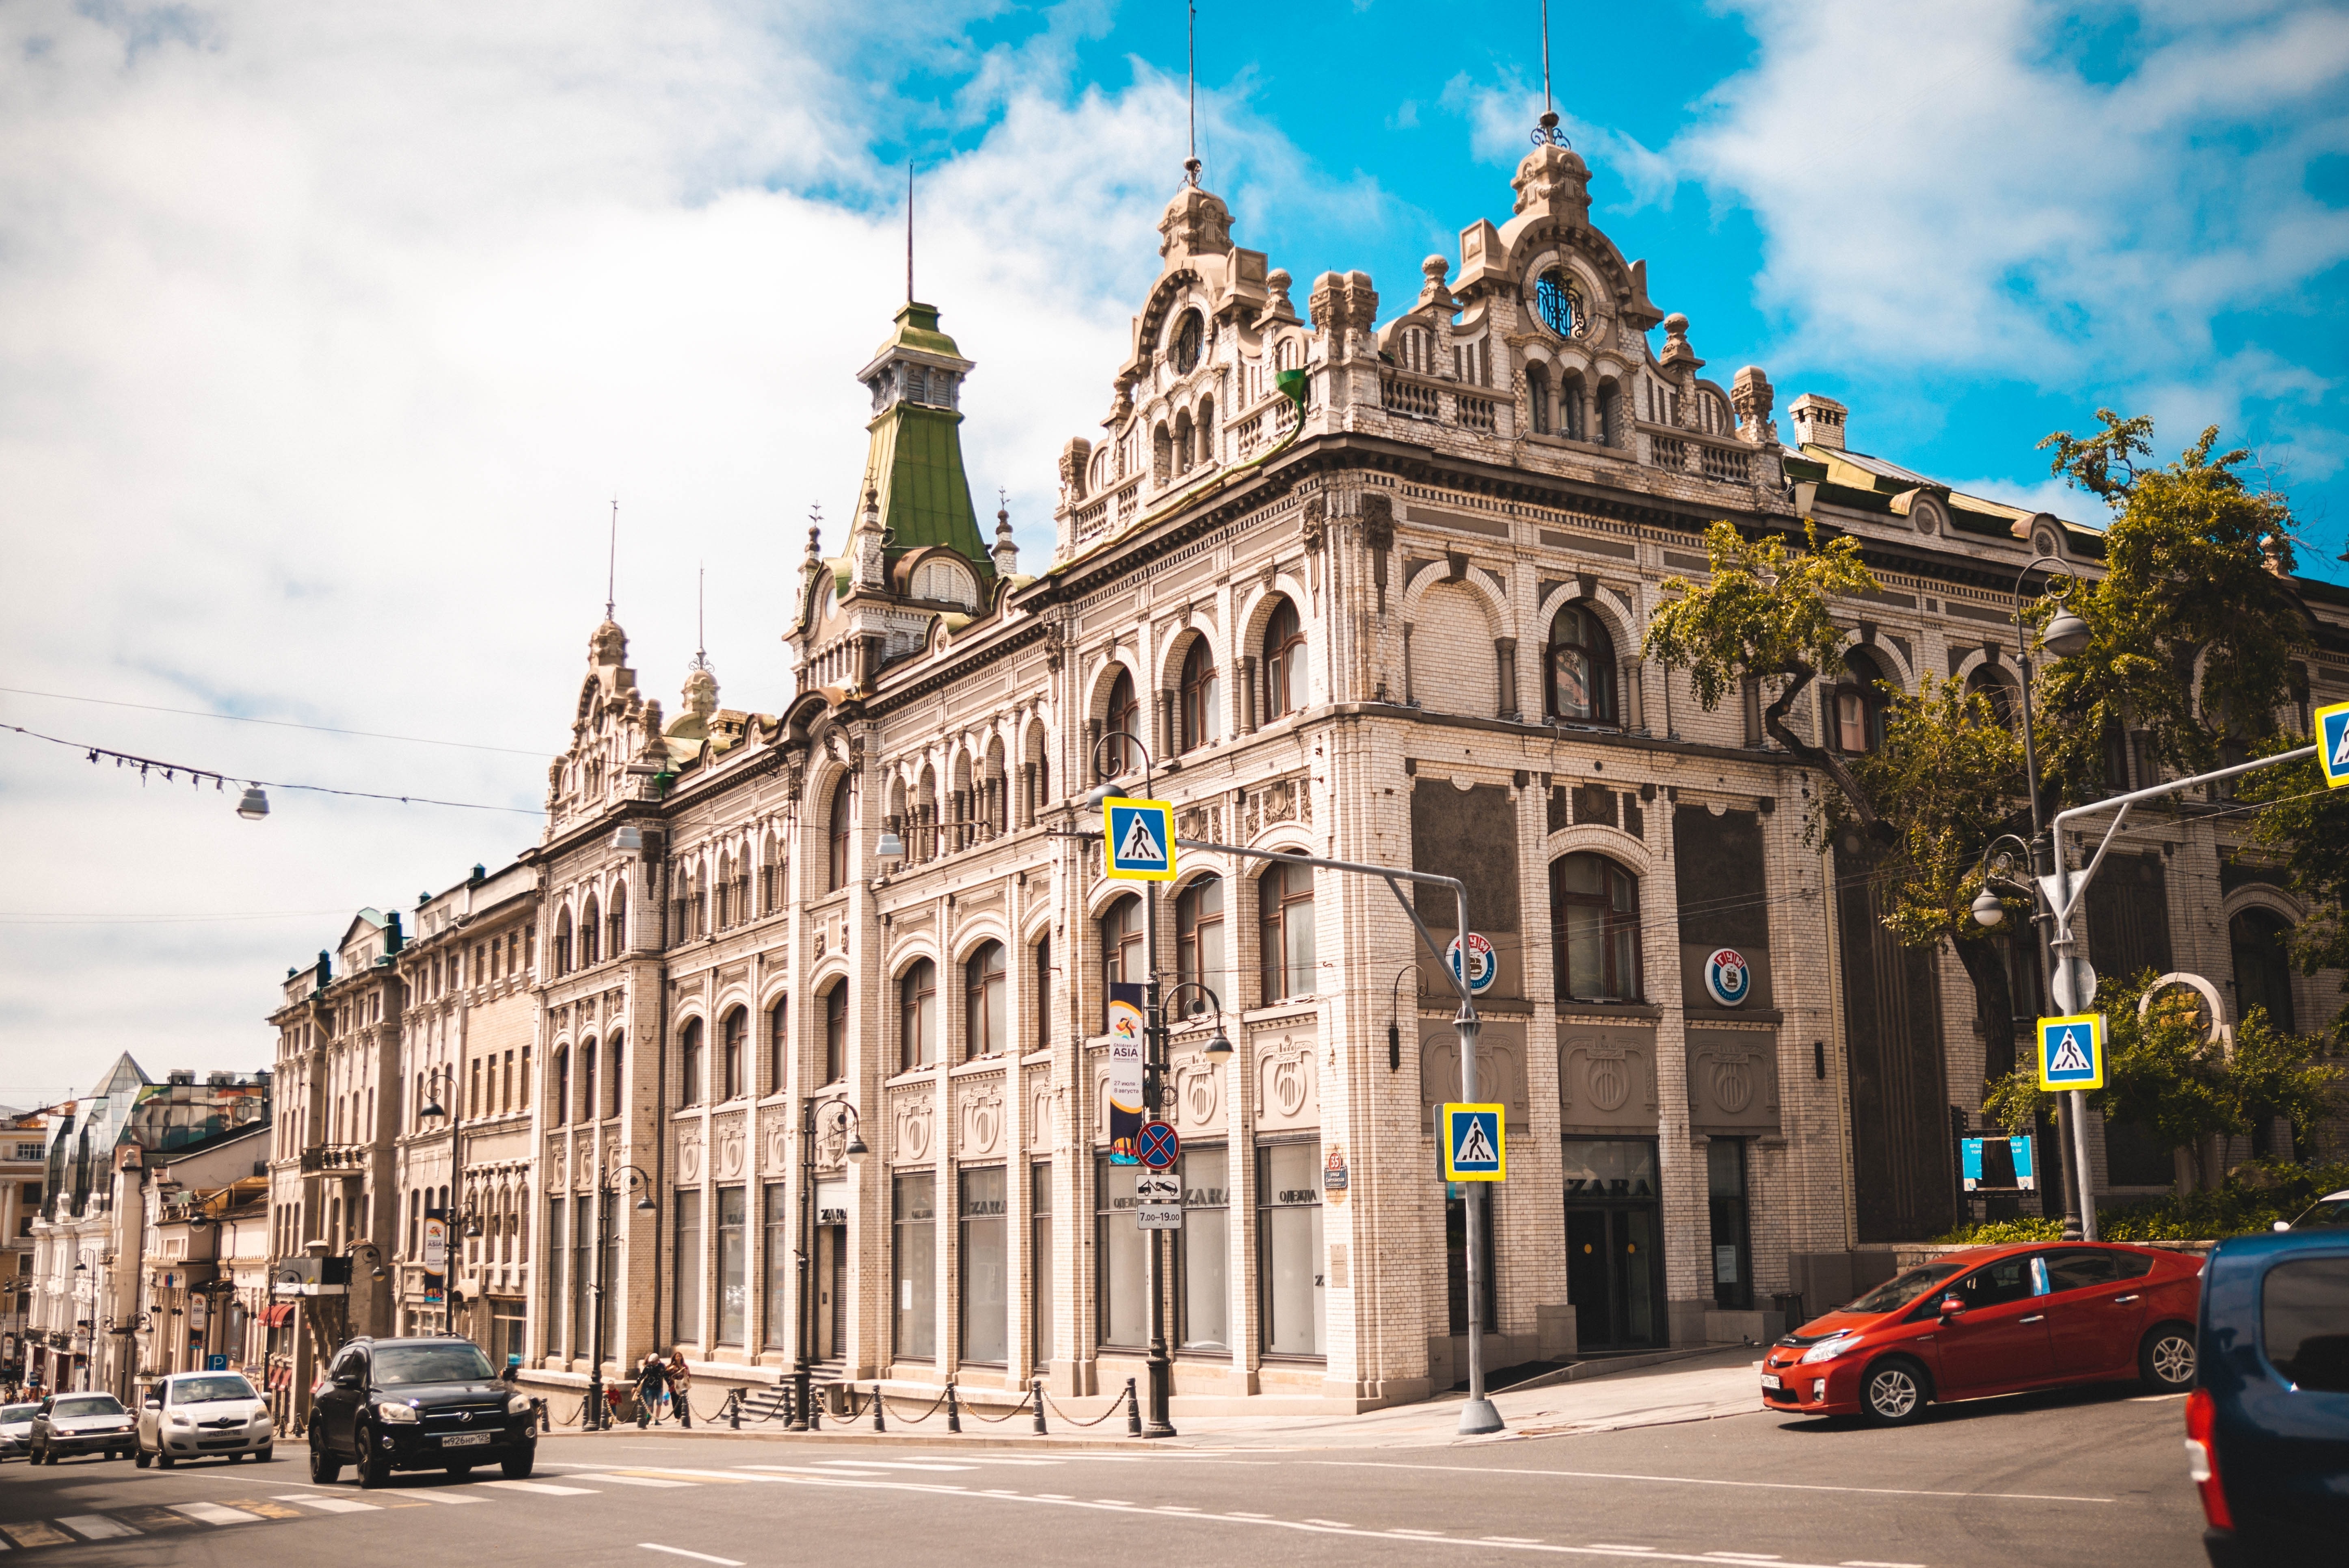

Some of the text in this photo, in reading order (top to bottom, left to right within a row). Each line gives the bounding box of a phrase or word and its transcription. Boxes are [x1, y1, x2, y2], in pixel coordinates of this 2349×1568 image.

[1717, 952, 1743, 967] ГУМ
[1113, 1047, 1138, 1057] ASIA
[1331, 1156, 1339, 1168] 35
[1567, 1179, 1655, 1196] ZARA
[1114, 1197, 1137, 1209] ОДЕЖ
[1279, 1189, 1317, 1204] ОДЕЖДА
[213, 1356, 223, 1370] P
